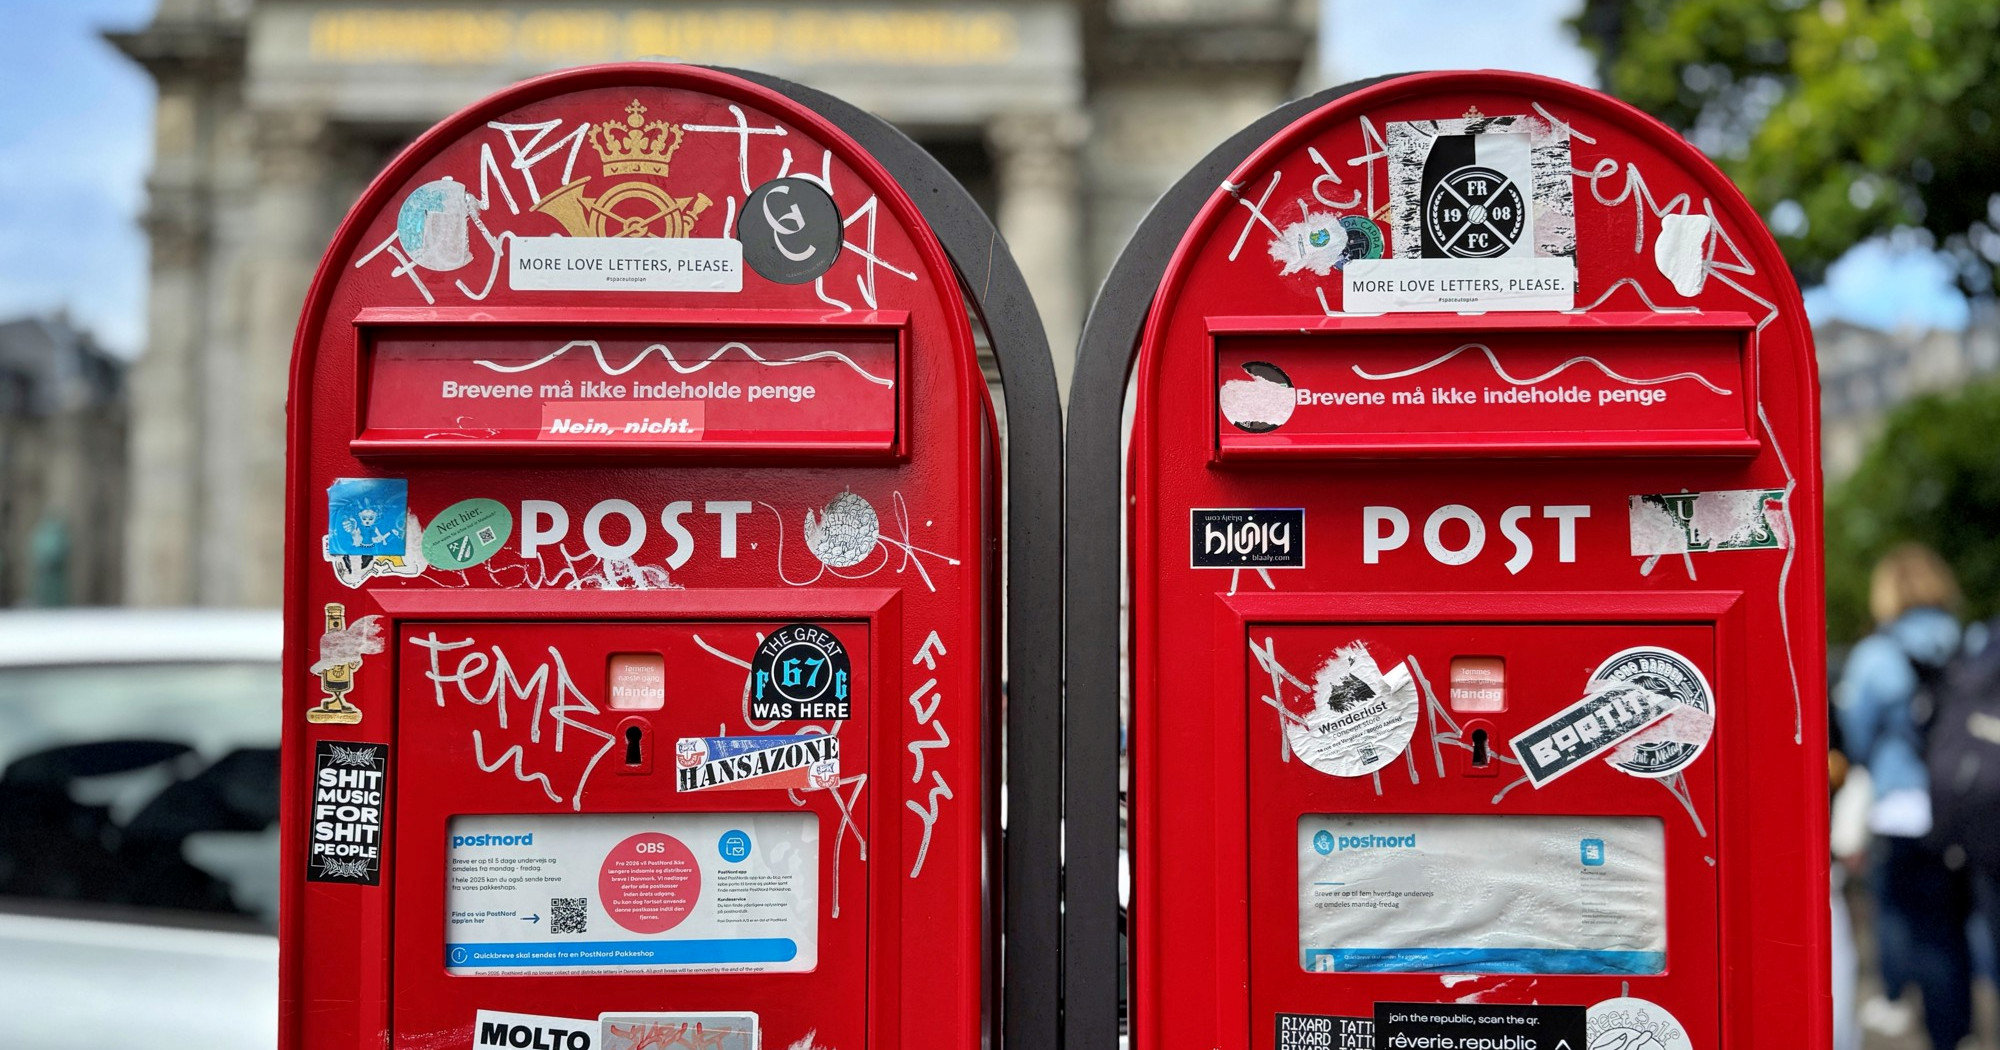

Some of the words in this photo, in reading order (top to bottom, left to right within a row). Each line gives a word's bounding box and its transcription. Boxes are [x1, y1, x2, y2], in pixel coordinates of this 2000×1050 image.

[1467, 180, 1488, 197] FR
[1443, 209, 1463, 223] 19
[1492, 206, 1511, 220] 08
[1468, 233, 1489, 249] FC
[519, 258, 561, 270] MORE
[567, 258, 602, 271] LOVE
[609, 258, 672, 273] LETTERS,
[678, 259, 734, 272] PLEASE.
[1352, 280, 1394, 292] MORE
[1400, 279, 1435, 292] LOVE
[1441, 279, 1503, 293] LETTERS,
[1509, 278, 1565, 291] PLEASE.
[442, 381, 533, 398] Brevene
[540, 379, 573, 398] må
[581, 381, 626, 398] ikke
[634, 380, 741, 398] indeholde
[748, 384, 816, 402] penge
[1296, 389, 1385, 405] Brevene
[1392, 386, 1425, 405] må
[1431, 386, 1477, 404] ikke
[1484, 385, 1592, 404] indeholde
[1599, 388, 1667, 406] penge
[550, 418, 616, 437] Nein,
[624, 417, 695, 435] nicht.
[436, 517, 460, 535] Nett
[459, 507, 483, 523] hier.
[521, 498, 753, 571] POST
[1363, 504, 1591, 575] POST
[1252, 554, 1290, 562] blaaly.com
[761, 631, 792, 657] THE
[794, 627, 842, 657] GREAT
[781, 657, 825, 688] 67
[612, 686, 664, 699] Mandag
[1451, 688, 1501, 701] Mandag
[753, 703, 792, 718] WAS
[800, 703, 848, 718] HERE
[1318, 700, 1388, 735] Wanderlust
[1332, 720, 1362, 739] concept
[1362, 716, 1380, 727] store
[679, 737, 839, 792] HANSAZONE
[319, 768, 382, 790] SHIT
[318, 788, 380, 805] MUSIC
[316, 804, 379, 824] FOR
[315, 821, 379, 843] SHIT
[453, 833, 533, 849] postnord
[636, 842, 665, 854] OBS
[1338, 834, 1416, 851] postnord
[314, 842, 377, 858] PEOPLE
[500, 858, 517, 866] dage
[518, 857, 547, 865] undervejs
[479, 884, 517, 892] pakkeshops.
[1372, 890, 1402, 898] hverdage
[1403, 890, 1434, 899] undervejs
[1351, 901, 1400, 909] mandag-fredag
[614, 950, 654, 958] Pakkeshop
[1281, 1016, 1332, 1032] RIXARD
[1389, 1013, 1408, 1024] join
[1410, 1013, 1428, 1023] the
[1430, 1013, 1476, 1025] republic,
[1478, 1016, 1504, 1024] scan
[1506, 1015, 1525, 1025] the
[1526, 1017, 1540, 1026] qr.
[480, 1021, 591, 1050] MOLTO
[1281, 1030, 1331, 1046] RIXARD
[1388, 1032, 1537, 1050] rêverie.republic
